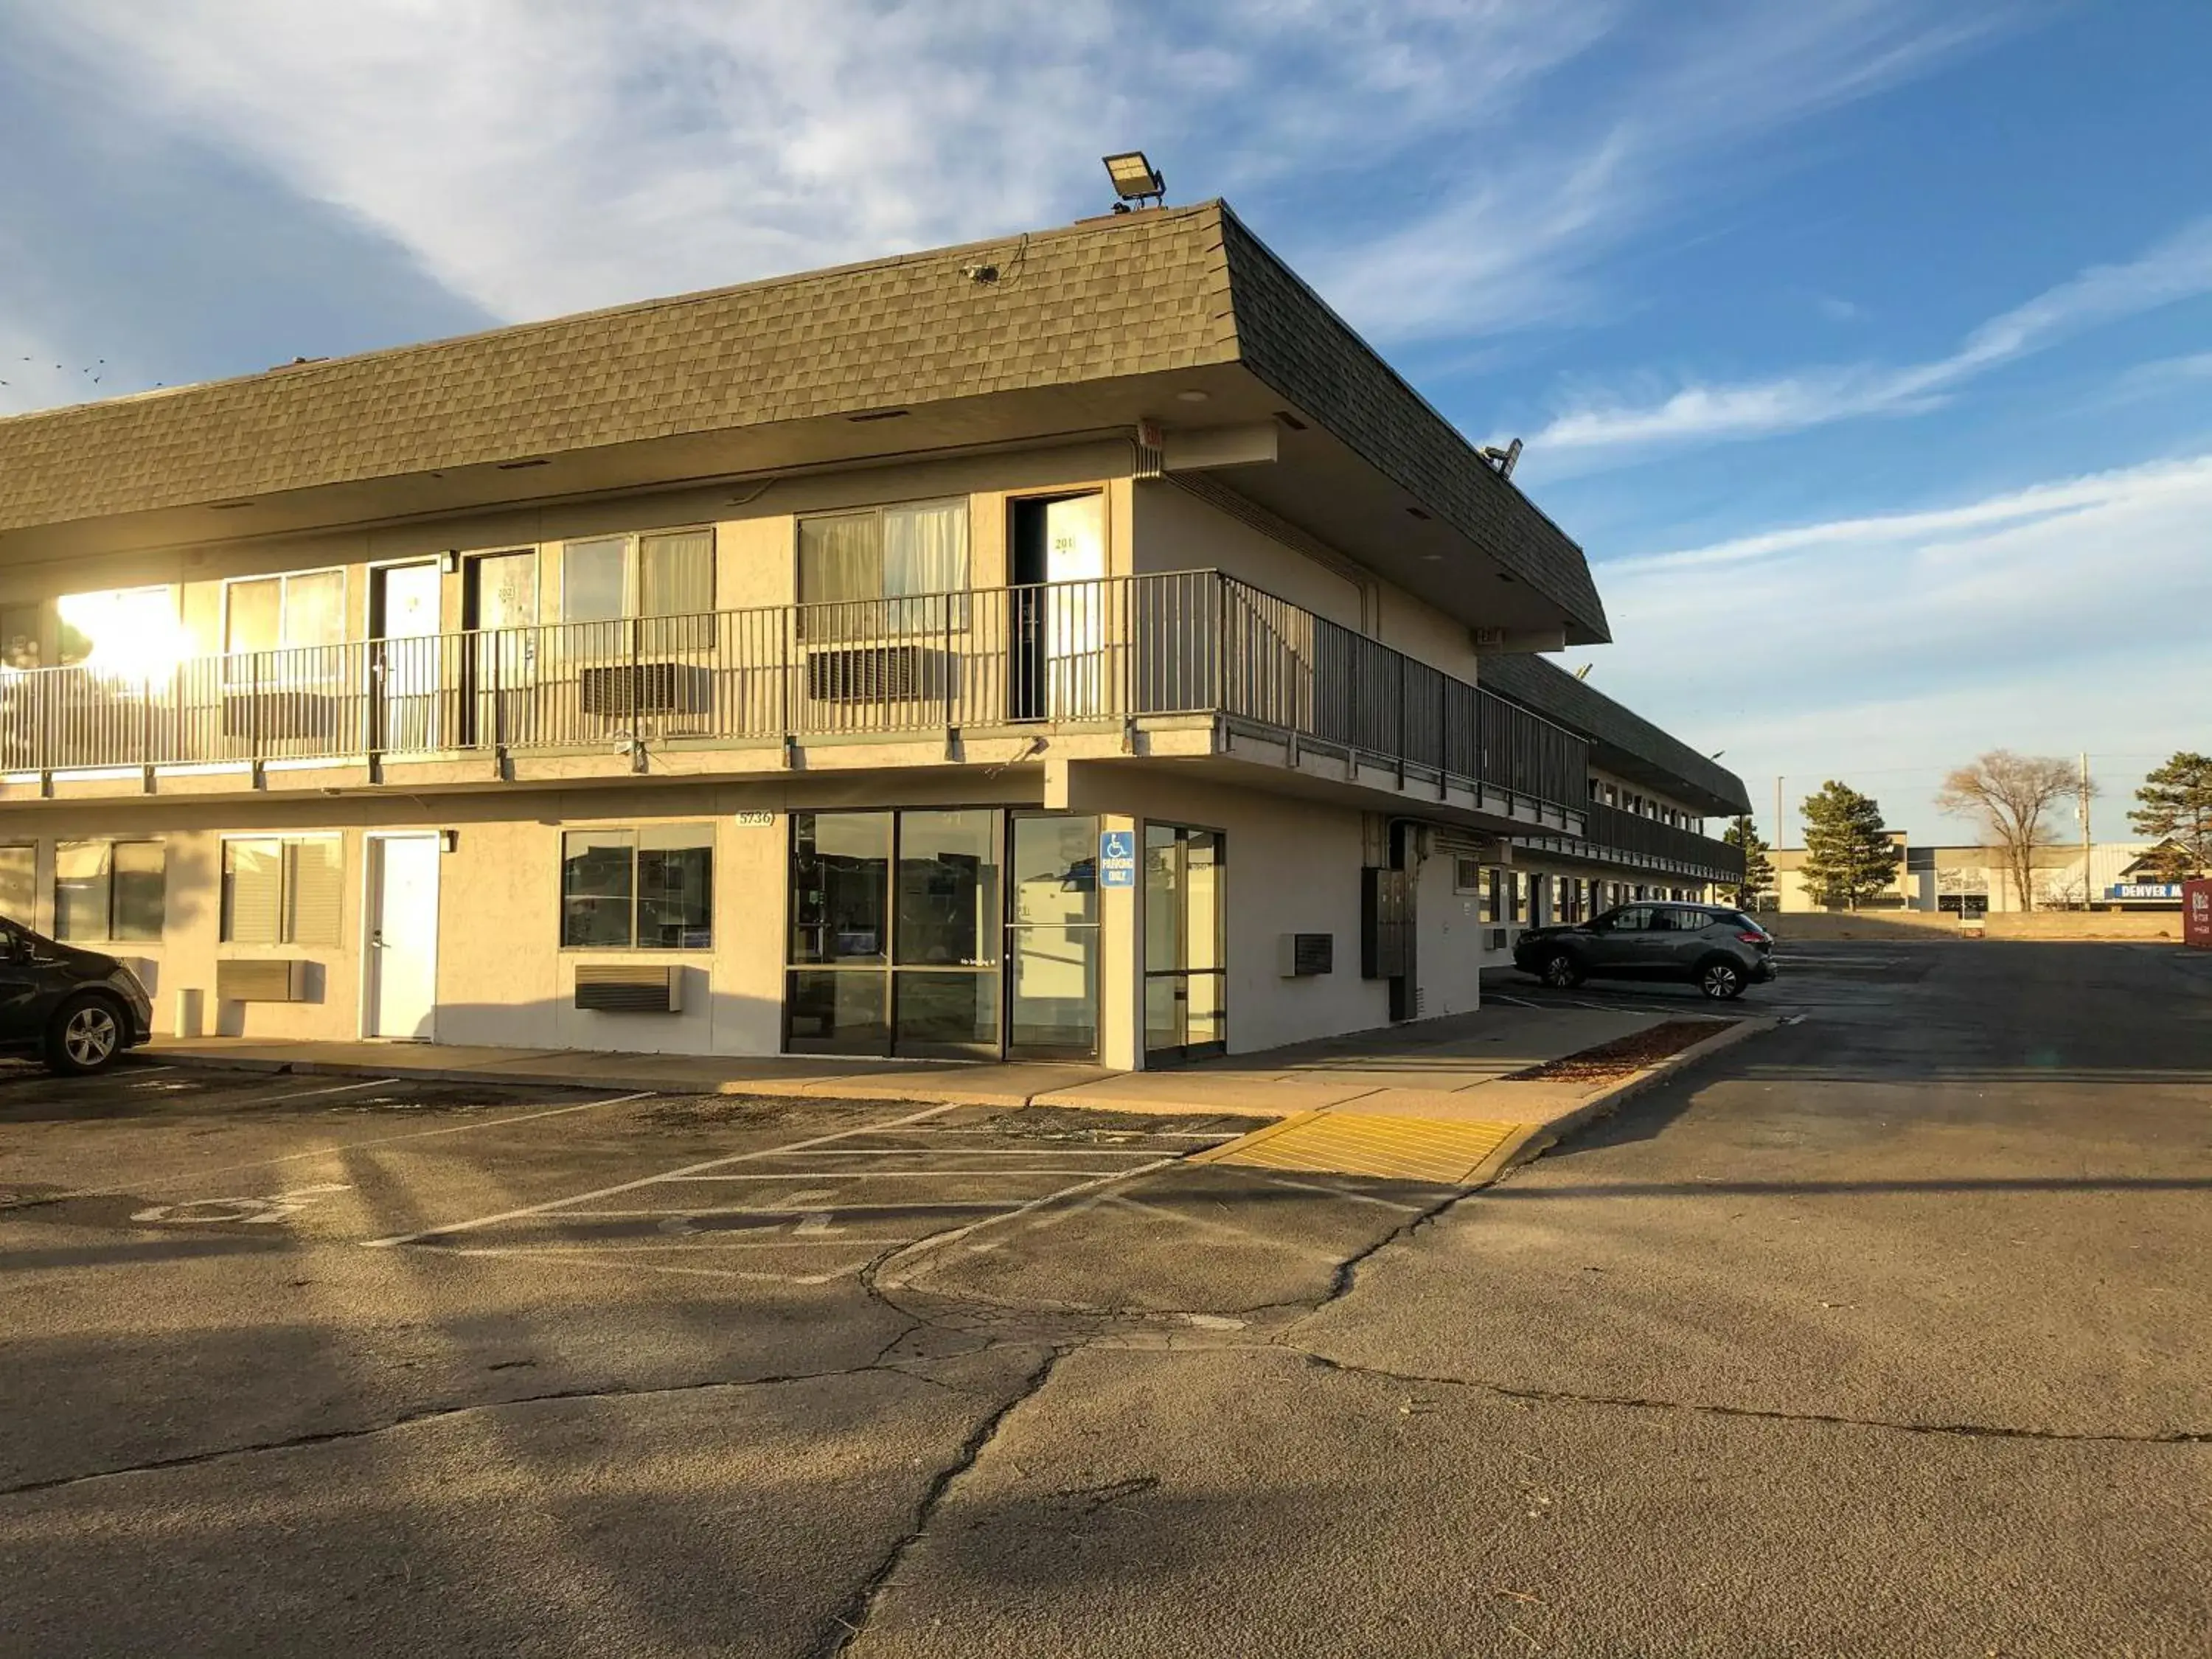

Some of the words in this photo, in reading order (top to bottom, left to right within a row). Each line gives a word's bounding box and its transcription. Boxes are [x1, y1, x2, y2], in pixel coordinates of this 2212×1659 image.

[1055, 538, 1073, 549] 201
[740, 811, 771, 824] 5736
[1102, 858, 1133, 869] PARKING
[1108, 871, 1127, 881] ONLY
[2121, 885, 2167, 897] DENVER
